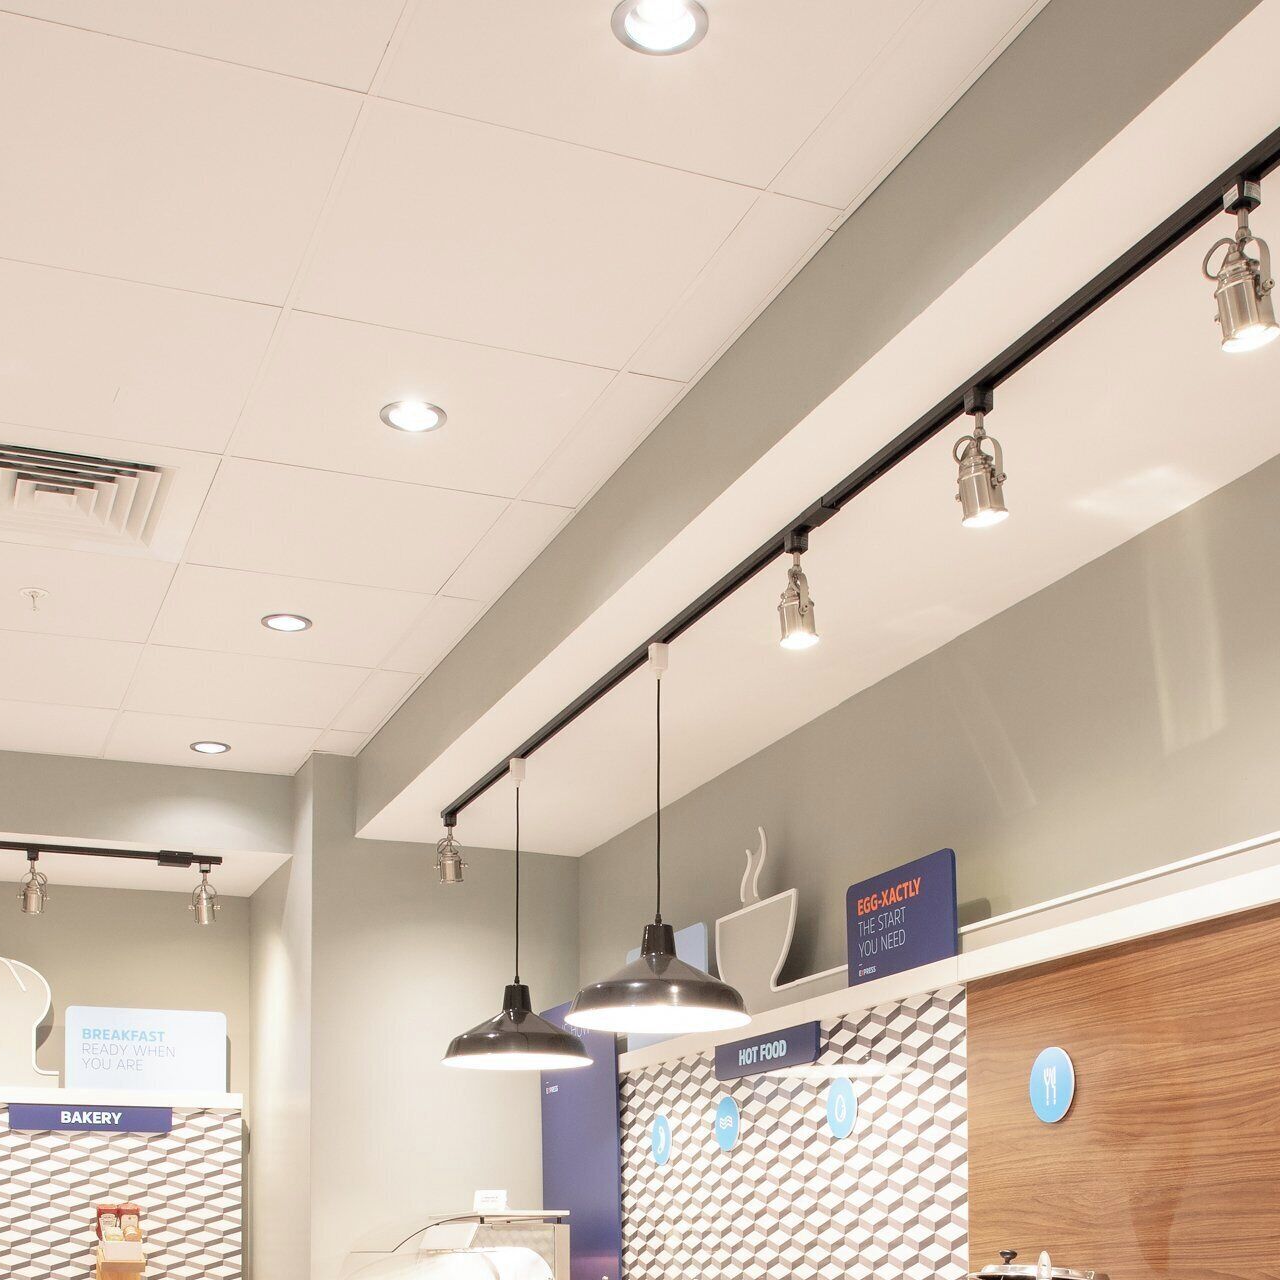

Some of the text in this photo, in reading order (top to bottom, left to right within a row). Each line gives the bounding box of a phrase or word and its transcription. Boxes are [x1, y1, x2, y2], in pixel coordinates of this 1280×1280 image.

[857, 877, 921, 916] EGG-XACTLY
[858, 906, 906, 937] THE START
[859, 929, 906, 958] YOU NEED
[82, 1028, 165, 1042] BREAKFAST
[82, 1042, 176, 1058] READY WHEN
[738, 1039, 787, 1066] HOT FOOD
[82, 1057, 144, 1072] YOU ARE
[61, 1110, 122, 1125] BAKERY
